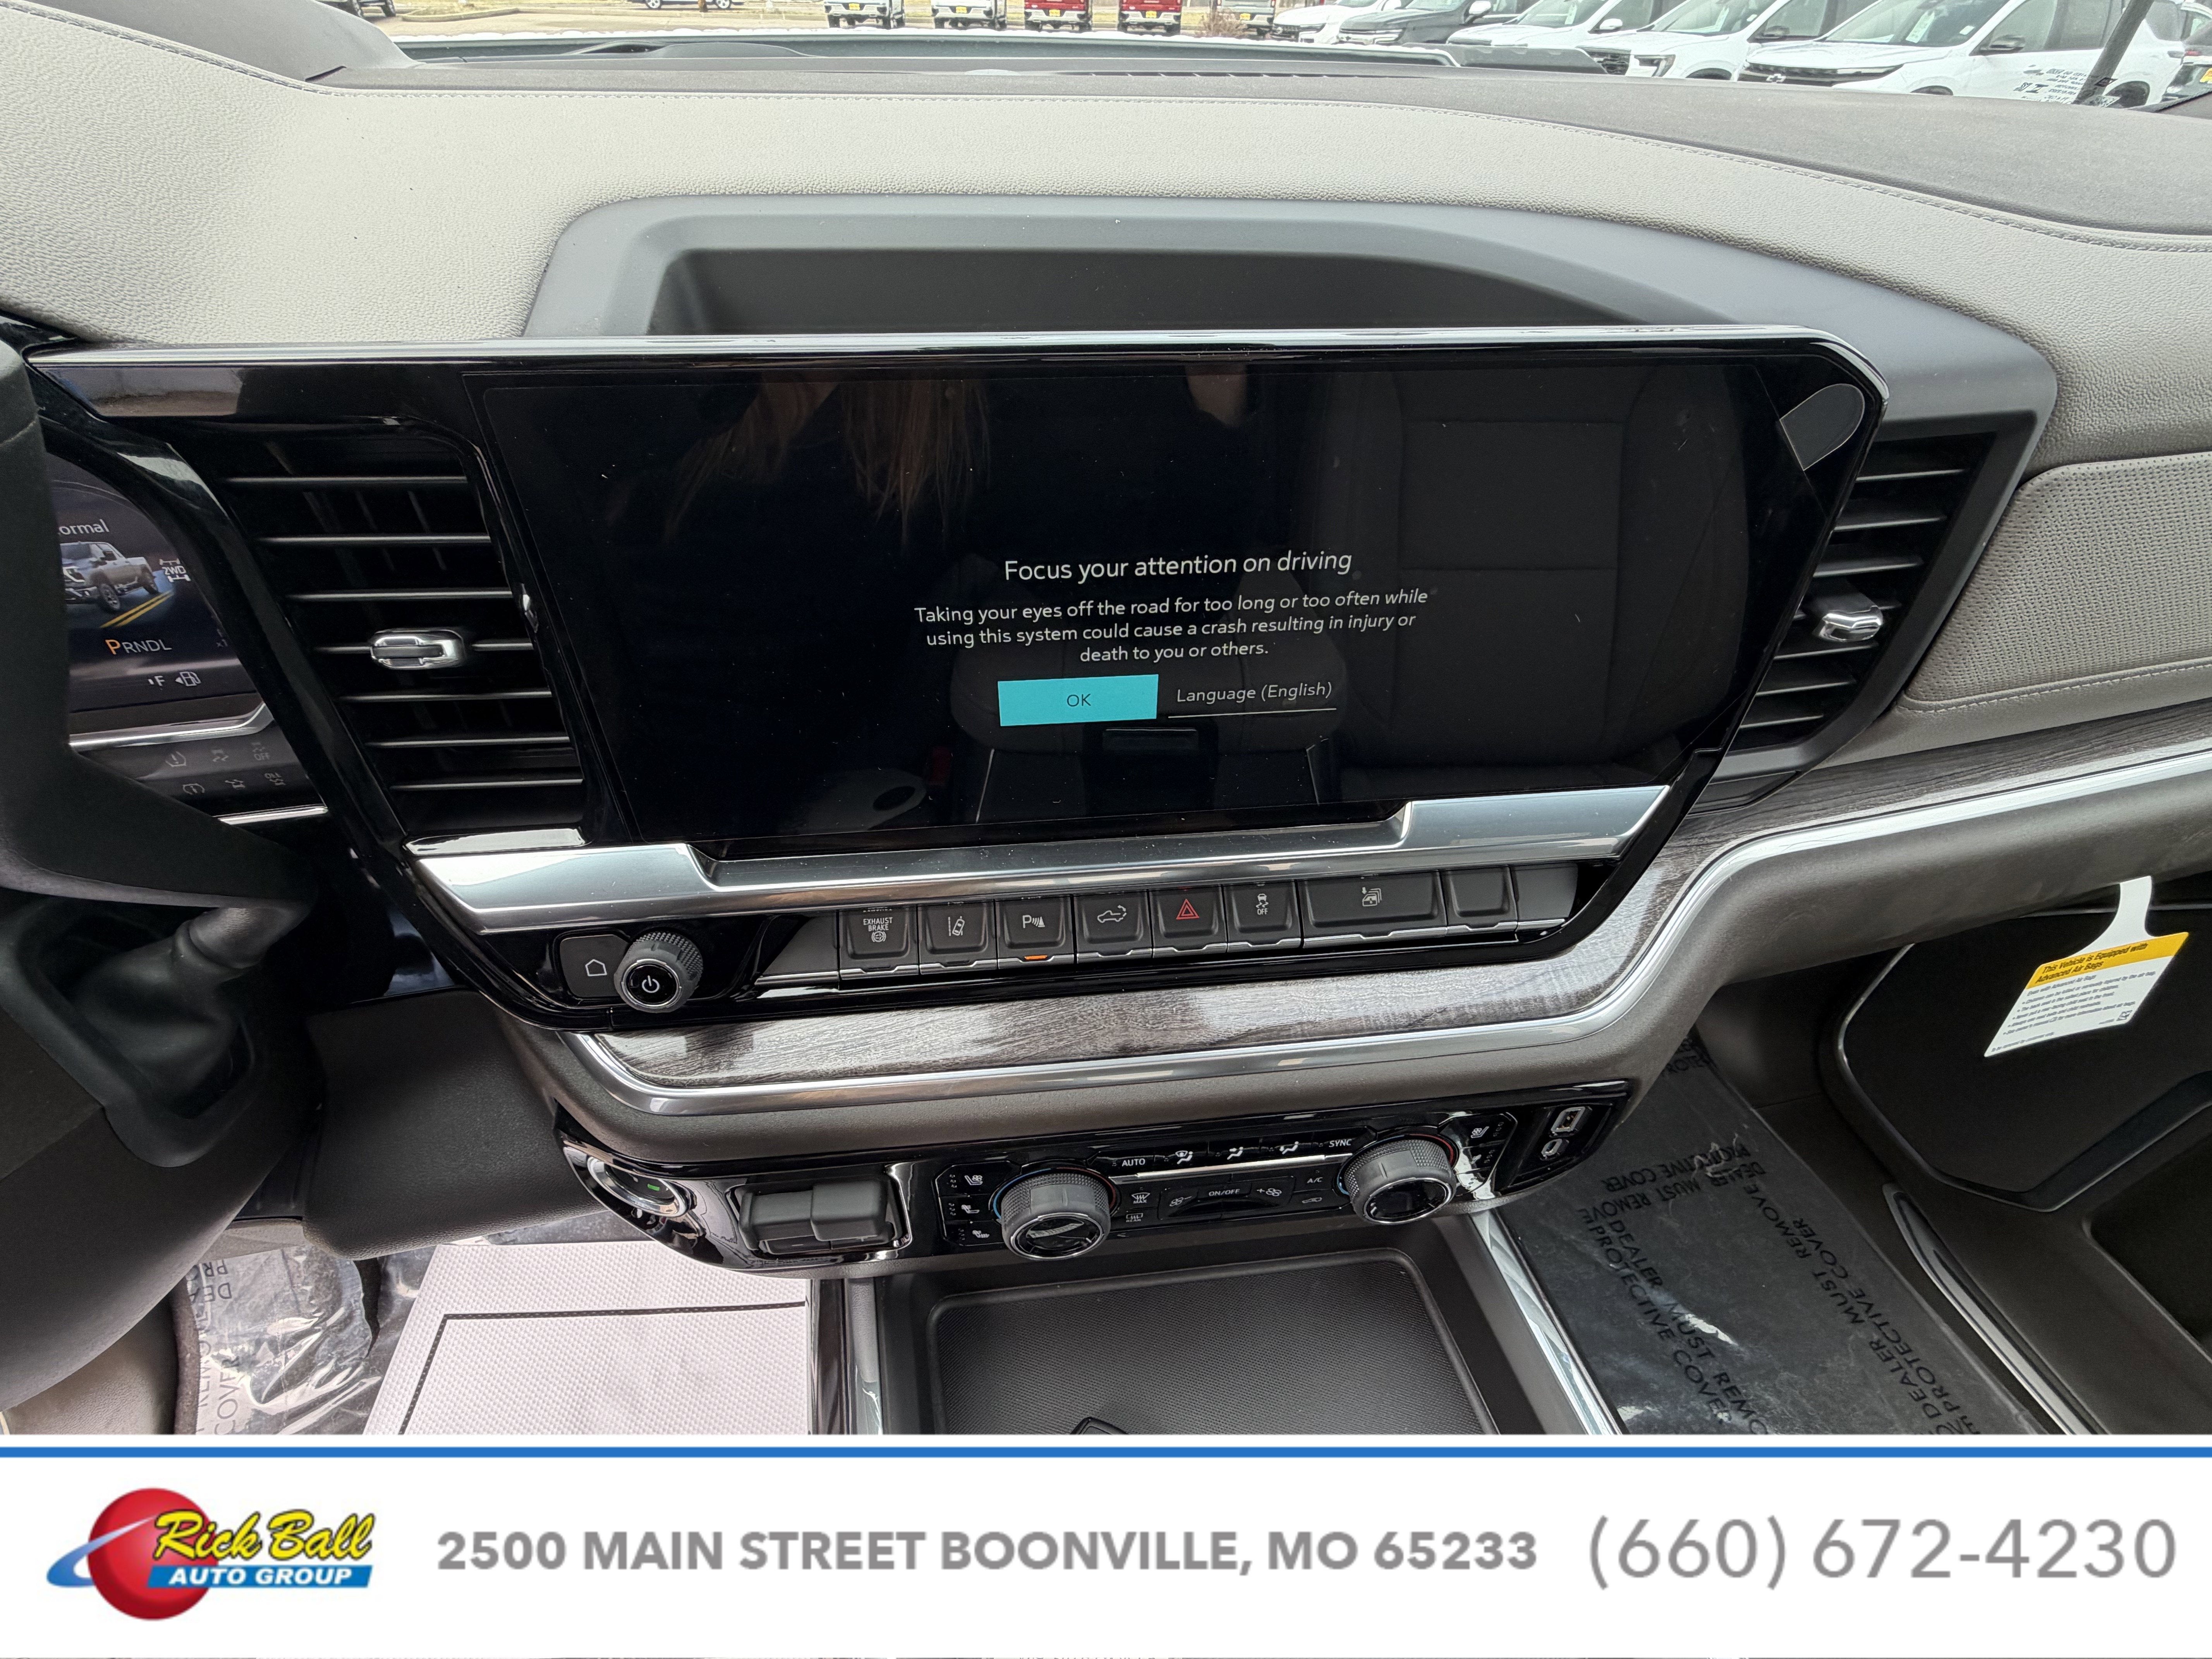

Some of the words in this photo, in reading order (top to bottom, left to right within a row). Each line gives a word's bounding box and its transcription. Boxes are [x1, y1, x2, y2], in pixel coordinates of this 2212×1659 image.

[58, 519, 110, 535] ormal
[161, 566, 186, 575] 2WD
[1005, 560, 1072, 580] Focus
[1078, 562, 1128, 584] your
[1134, 555, 1237, 576] attention
[1243, 557, 1271, 572] on
[1278, 550, 1352, 575] driving
[914, 606, 974, 625] Taking
[978, 607, 1018, 624] your
[1022, 606, 1062, 623] eyes
[1066, 600, 1094, 617] off
[1097, 600, 1126, 615] the
[1130, 598, 1170, 614] road
[1175, 597, 1200, 613] for
[1204, 598, 1233, 612] too
[1238, 595, 1274, 613] long
[1279, 597, 1298, 608] or
[1302, 593, 1330, 607] too
[1334, 591, 1380, 606] often
[1384, 588, 1428, 605] while
[927, 632, 974, 648] using
[979, 628, 1011, 644] this
[1016, 628, 1077, 646] system
[1083, 623, 1128, 639] could
[1134, 624, 1183, 637] cause
[1187, 624, 1197, 635] a
[1201, 619, 1247, 635] crash
[1252, 616, 1324, 634] resulting
[1329, 616, 1343, 629] in
[1348, 615, 1394, 631] injury
[1397, 615, 1416, 627] or
[1080, 646, 1128, 662] death
[1133, 646, 1150, 659] to
[1153, 648, 1184, 663] you
[1188, 646, 1207, 657] or
[1211, 641, 1268, 656] others.
[1066, 693, 1092, 708] OK
[1176, 688, 1256, 705] Language
[1261, 682, 1333, 702] (English)
[863, 917, 893, 925] EXHAUST
[1329, 1139, 1352, 1147] SYNC
[1122, 1158, 1146, 1167] AUTO
[1208, 1188, 1240, 1197] ON/OFF
[1601, 1168, 1656, 1192] COVER
[1656, 1178, 1702, 1202] MUST
[1577, 1192, 1652, 1224] REMOVE
[1744, 1184, 1812, 1258] REMOVE
[1793, 1218, 1848, 1279] COVER
[1589, 1225, 1674, 1341] PROTECTIVE
[1608, 1220, 1663, 1288] DEALER
[1666, 1302, 1715, 1358] MUST
[1813, 1270, 1865, 1324] MUST
[1848, 1288, 1960, 1412] PROTECTIVE
[1869, 1339, 1941, 1419] DEALER
